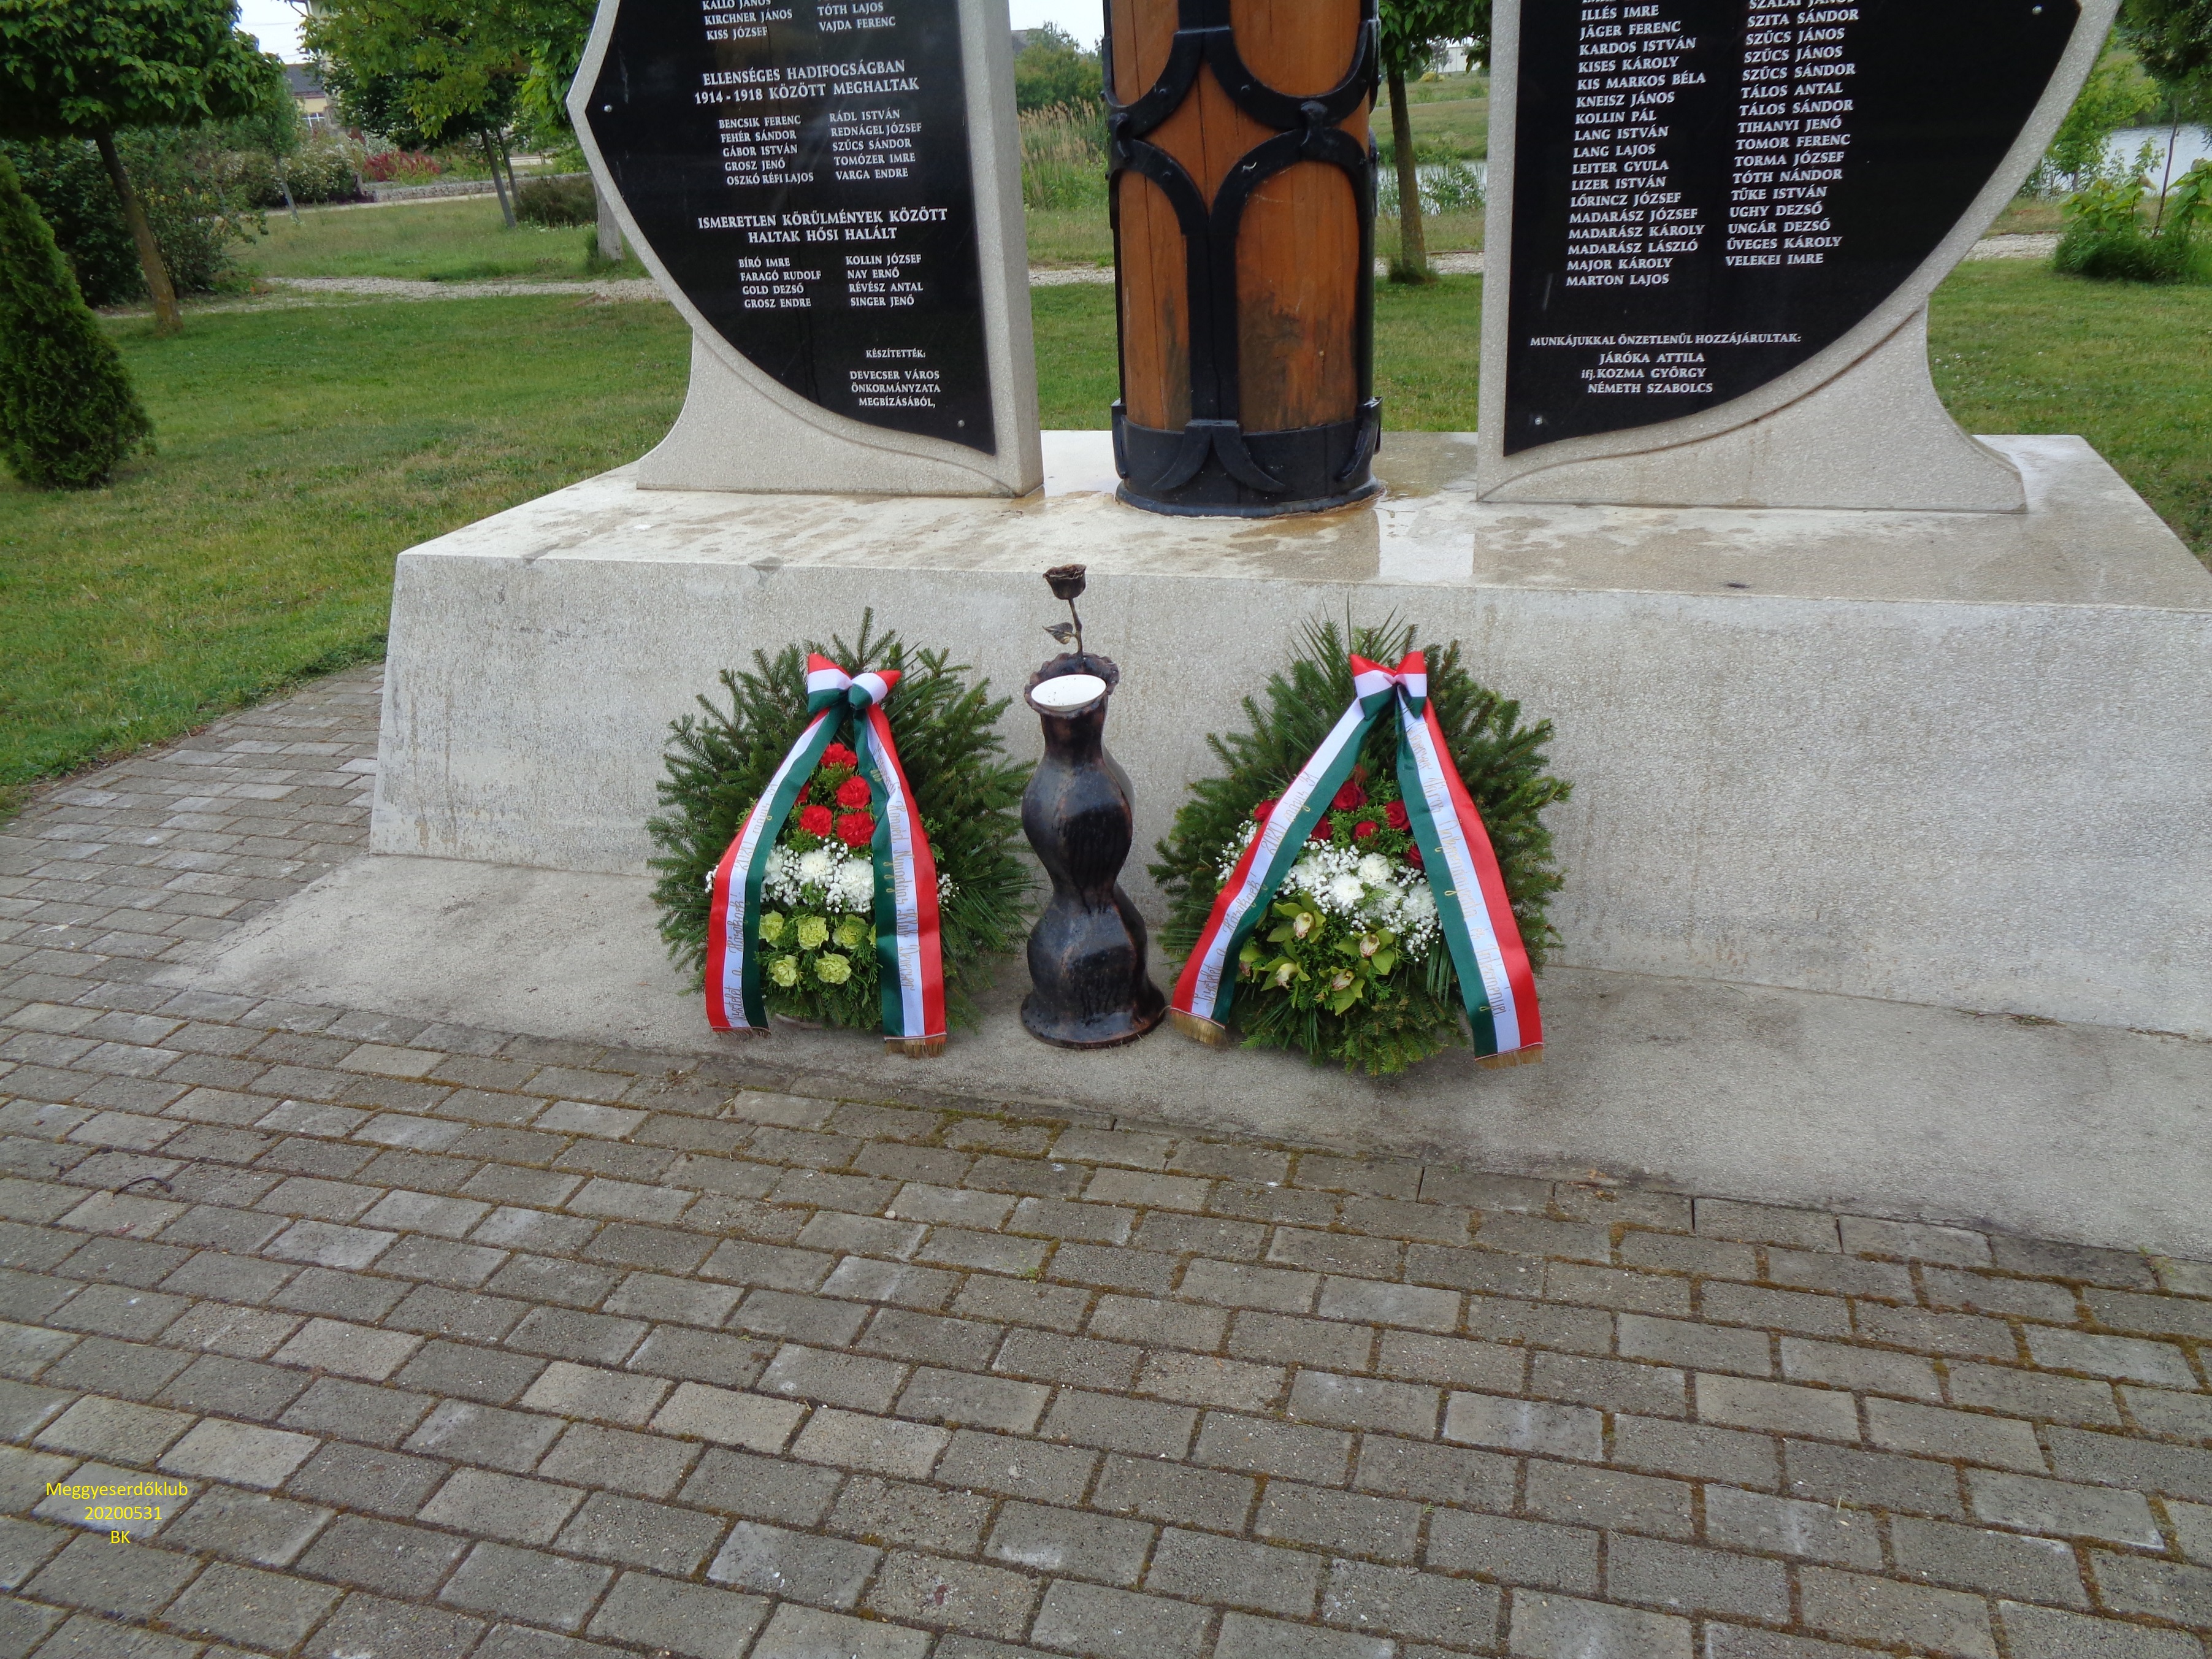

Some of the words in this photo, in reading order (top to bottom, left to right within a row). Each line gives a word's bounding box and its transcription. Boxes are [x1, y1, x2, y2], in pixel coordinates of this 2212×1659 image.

[817, 4, 847, 16] TÓTH
[852, 2, 883, 14] LAJOS
[1582, 6, 1617, 21] ILLÉS
[1623, 5, 1659, 18] IMRE
[704, 13, 756, 25] KIRCHNER
[761, 9, 792, 23] JÁNOS
[1747, 14, 1789, 28] SZITA
[1797, 9, 1859, 24] SÁNDOR
[819, 20, 852, 33] VAJDA
[857, 17, 895, 28] FERENC
[1629, 21, 1681, 35] FERENC
[706, 29, 728, 40] KISS
[733, 26, 767, 40] JÓZSEF
[1797, 28, 1845, 44] JÁNOS
[1579, 42, 1636, 56] KARDOS
[1643, 36, 1696, 52] ISTVÁN
[1795, 45, 1843, 62] JÁNOS
[1579, 60, 1615, 73] KISES
[1622, 56, 1679, 71] KÁROLY
[1794, 63, 1856, 78] SÁNDOR
[703, 67, 780, 86] ELLENSÉGES
[787, 60, 905, 80] HADIFOGSÁGBAN
[1577, 79, 1600, 90] KIS
[1605, 75, 1665, 88] MARKOS
[1672, 70, 1706, 85] BÉLA
[734, 88, 762, 102] 1918
[769, 83, 825, 99] KÖZÖTT
[834, 77, 919, 94] MEGHALTAK
[1741, 84, 1788, 99] TÁLOS
[1794, 82, 1843, 96] ANTAL
[1576, 94, 1625, 108] KNEISZ
[1630, 91, 1675, 107] JÁNOS
[829, 110, 857, 122] RÁDL
[862, 107, 900, 120] ISTVÁN
[1739, 103, 1785, 116] TÁLOS
[1793, 99, 1853, 113] SÁNDOR
[719, 118, 760, 129] BENCSIK
[764, 115, 801, 126] FERENC
[1575, 112, 1625, 125] KOLLIN
[1631, 108, 1656, 121] PÁL
[831, 124, 884, 137] REDNÁGEL
[886, 122, 921, 136] JÓZSEF
[1574, 129, 1610, 141] LANG
[1617, 124, 1669, 139] ISTVÁN
[1737, 120, 1799, 133] TIHANYI
[721, 130, 751, 143] FEHÉR
[756, 129, 796, 141] SÁNDOR
[869, 137, 911, 149] SÁNDOR
[1736, 137, 1789, 150] TOMOR
[1796, 134, 1850, 147] FERENC
[723, 145, 756, 157] GÁBOR
[761, 142, 797, 155] ISTVÁN
[1574, 146, 1609, 158] LANG
[1615, 144, 1655, 157] LAJOS
[725, 161, 757, 171] GROSZ
[762, 157, 785, 171] JENŐ
[834, 153, 885, 166] TOMÓZER
[890, 153, 916, 163] IMRE
[1734, 155, 1786, 167] TORMA
[1793, 150, 1844, 166] JÓZSEF
[835, 170, 870, 180] VARGA
[874, 168, 908, 178] ENDRE
[1572, 162, 1617, 174] LEITER
[1624, 160, 1669, 172] GYULA
[727, 173, 760, 185] OSZKÓ
[762, 172, 783, 184] RÉFI
[785, 172, 813, 184] LAJOS
[1572, 179, 1609, 191] LIZER
[1615, 174, 1666, 189] ISTVÁN
[1732, 170, 1774, 183] TÓTH
[1779, 169, 1843, 182] NÁNDOR
[1633, 191, 1681, 207] JÓZSEF
[1772, 186, 1827, 199] ISTVÁN
[698, 215, 776, 229] ISMERETLEN
[783, 209, 883, 225] KÖRÜLMÉNYEK
[889, 206, 947, 222] KÖZÖTT
[1569, 209, 1644, 223] MADARÁSZ
[1649, 207, 1697, 223] JÓZSEF
[1730, 206, 1770, 217] UGHY
[748, 231, 800, 243] HALTAK
[806, 227, 838, 241] HŐSI
[845, 225, 897, 240] HALÁLT
[1568, 225, 1643, 239] MADARÁSZ
[1649, 225, 1705, 236] KÁROLY
[1728, 220, 1777, 234] UNGÁR
[1567, 243, 1642, 255] MADARÁSZ
[1648, 238, 1698, 252] LÁSZLÓ
[1784, 237, 1843, 248] KÁROLY
[738, 256, 761, 268] BÍRÓ
[766, 258, 790, 267] IMRE
[846, 255, 882, 265] KOLLIN
[887, 252, 921, 266] JÓZSEF
[1567, 259, 1612, 272] MAJOR
[1618, 256, 1673, 269] KÁROLY
[1725, 255, 1781, 266] VELEKEI
[1787, 253, 1823, 264] IMRE
[740, 269, 779, 281] FARAGÓ
[783, 270, 821, 280] RUDOLF
[848, 270, 867, 278] NAY
[1566, 275, 1624, 286] MARTON
[1629, 274, 1669, 286] LAJOS
[743, 286, 768, 294] GOLD
[849, 281, 885, 293] RÉVÉSZ
[890, 282, 923, 291] ANTAL
[744, 299, 776, 308] GROSZ
[780, 298, 811, 308] ENDRE
[851, 297, 886, 307] SINGER
[1530, 334, 1616, 347] MUNKÁJUKKAL
[866, 348, 925, 358] KÉSZÍTETTÉK:
[1599, 351, 1650, 365] JÁRÓKA
[1656, 353, 1705, 362] ATTILA
[849, 371, 900, 380] DEVECSER
[905, 369, 940, 379] VÁROS
[1651, 366, 1707, 378] GYÖRGY
[851, 382, 941, 393] ÖNKORMÁNYZATA
[1588, 381, 1641, 393] NÉMETH
[1647, 383, 1713, 393] SZABOLCS
[859, 396, 935, 408] MEGBÍZÁSÁBÓL,
